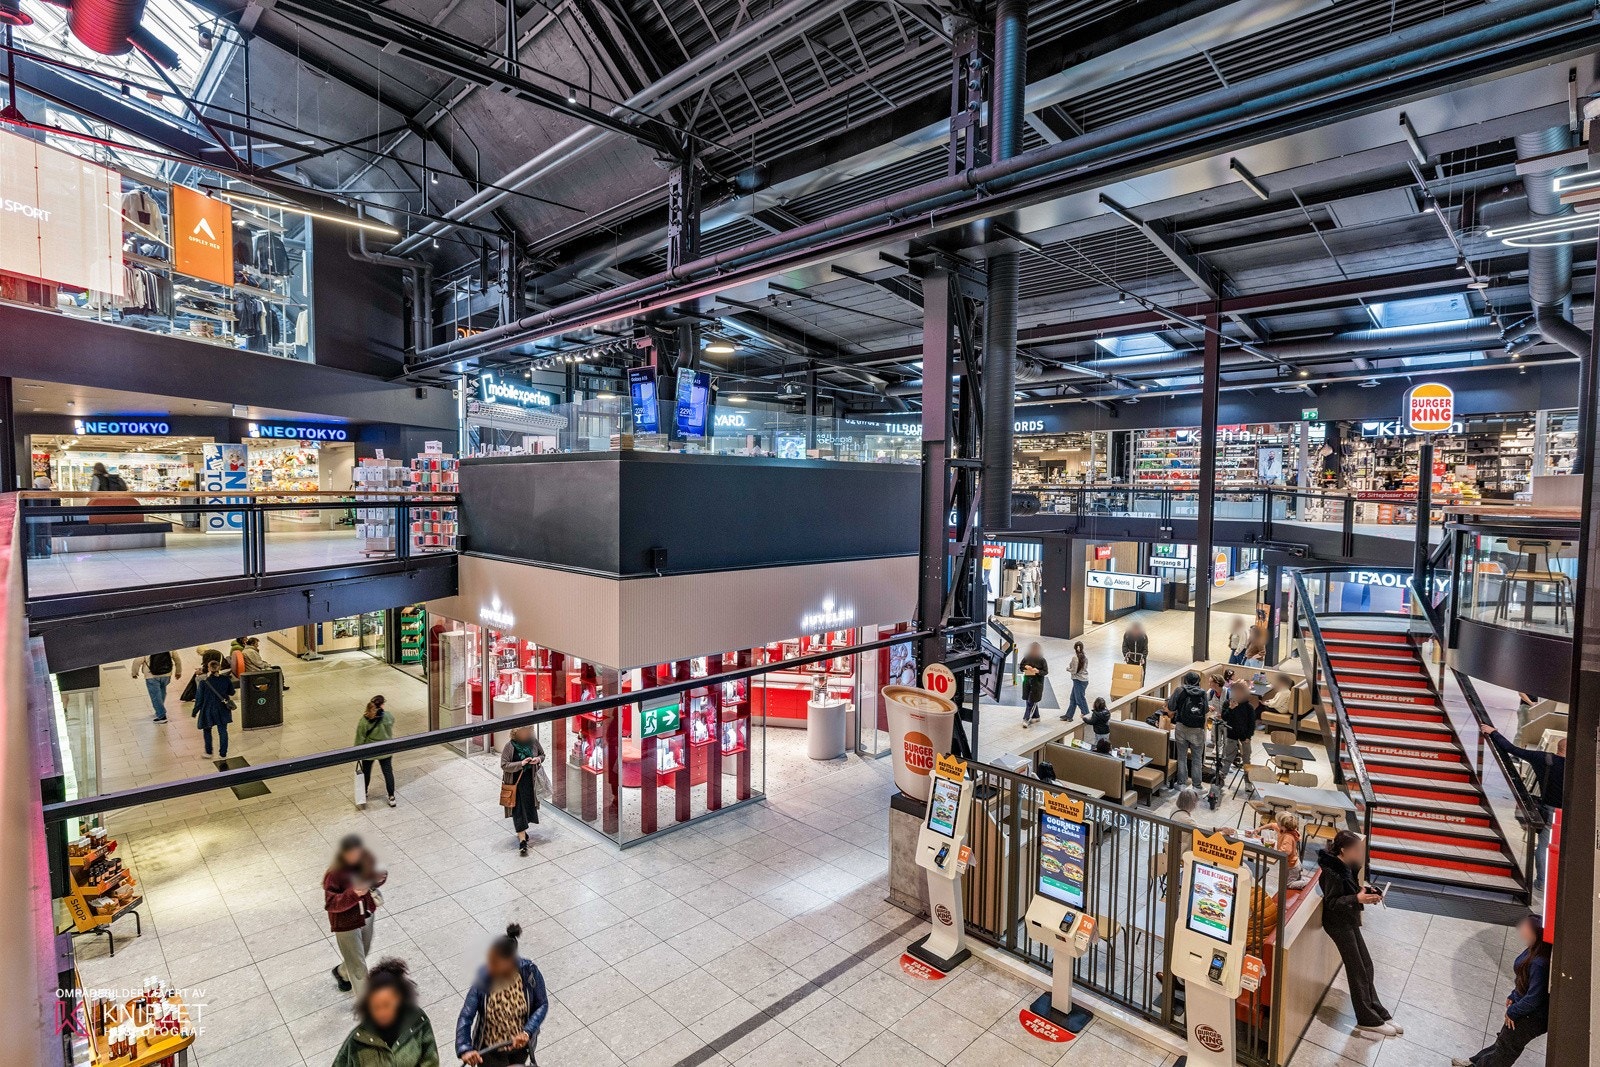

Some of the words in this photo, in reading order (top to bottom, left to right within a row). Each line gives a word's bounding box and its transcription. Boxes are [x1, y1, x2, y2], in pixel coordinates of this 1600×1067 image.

[5, 200, 52, 221] SPORT
[488, 380, 550, 406] mobilexperten
[1411, 398, 1452, 408] BURGER
[714, 414, 746, 426] YARD.
[1411, 408, 1451, 421] KING
[85, 422, 169, 435] NEOTOKYO
[1014, 420, 1044, 432] ORDS
[260, 426, 347, 441] NEOTOKYO
[1188, 428, 1250, 442] Kh'n
[207, 471, 225, 528] TOKO
[1114, 578, 1130, 586] Aleris
[926, 672, 948, 693] 10
[1352, 692, 1398, 701] SITTEPLASSER
[904, 741, 934, 757] BURGER
[1369, 745, 1421, 757] SITTEPLASSER
[1420, 751, 1439, 759] OPPE
[904, 750, 934, 769] KING
[1048, 800, 1069, 810] BESTILL
[1069, 805, 1080, 813] VED
[1049, 804, 1078, 817] SKJERMEN
[1390, 808, 1446, 820] SITTEPLASSER
[1445, 815, 1466, 823] OPPE
[1046, 816, 1081, 832] GOURMET
[1197, 840, 1223, 852] BESTILL
[1224, 848, 1237, 857] VED
[1199, 847, 1234, 861] SKJERMEN
[1197, 867, 1211, 877] THE
[1211, 871, 1232, 883] KINGS
[71, 898, 87, 921] SHOP
[937, 911, 952, 921] KING
[1083, 920, 1092, 930] 70
[904, 962, 931, 980] TRACK
[911, 961, 932, 973] FAST
[1246, 961, 1259, 972] 26
[1025, 1019, 1060, 1041] TRACK
[1033, 1018, 1059, 1033] FAST
[1197, 1029, 1222, 1039] BURGER
[1199, 1034, 1223, 1046] KING
